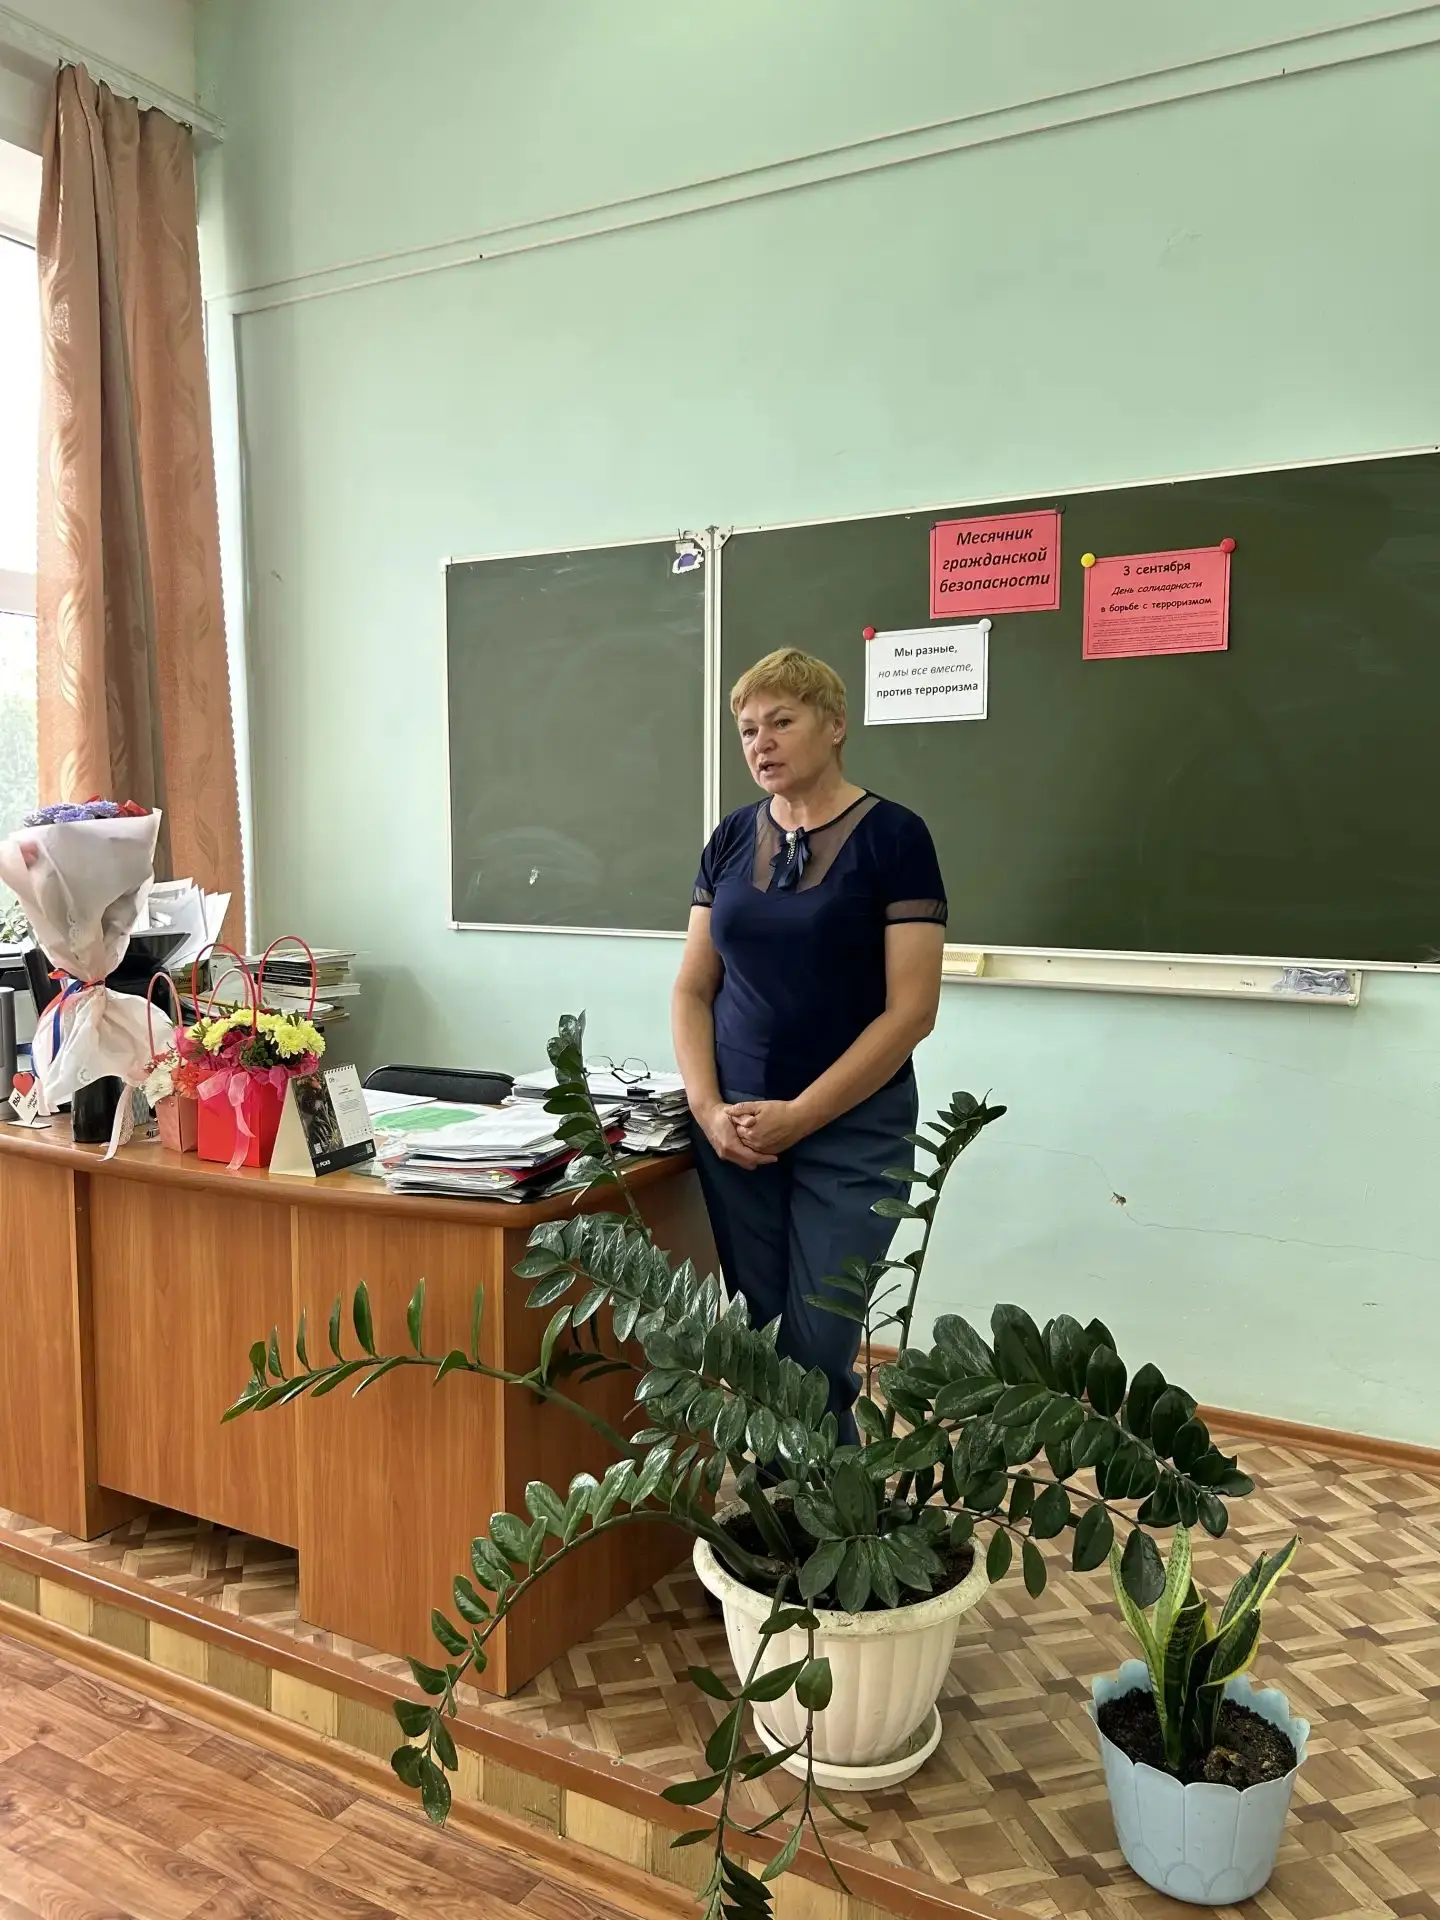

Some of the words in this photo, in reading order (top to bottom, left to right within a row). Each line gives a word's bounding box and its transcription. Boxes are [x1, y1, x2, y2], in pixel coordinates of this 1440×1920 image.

[956, 526, 1033, 546] Месячник
[942, 547, 1048, 571] гражданской
[1123, 565, 1131, 576] 3
[1136, 561, 1191, 575] сентября
[939, 572, 1050, 592] безопасности
[1111, 586, 1134, 596] День
[1137, 580, 1203, 593] солидарности
[1109, 602, 1139, 614] борьбе
[1152, 597, 1212, 610] терроризмом
[894, 646, 913, 658] Мы
[915, 643, 958, 658] разные,
[878, 668, 890, 679] но
[892, 667, 909, 678] мы
[911, 666, 928, 676] все
[930, 663, 974, 675] вместе,
[876, 685, 913, 699] против
[914, 681, 978, 695] терроризма
